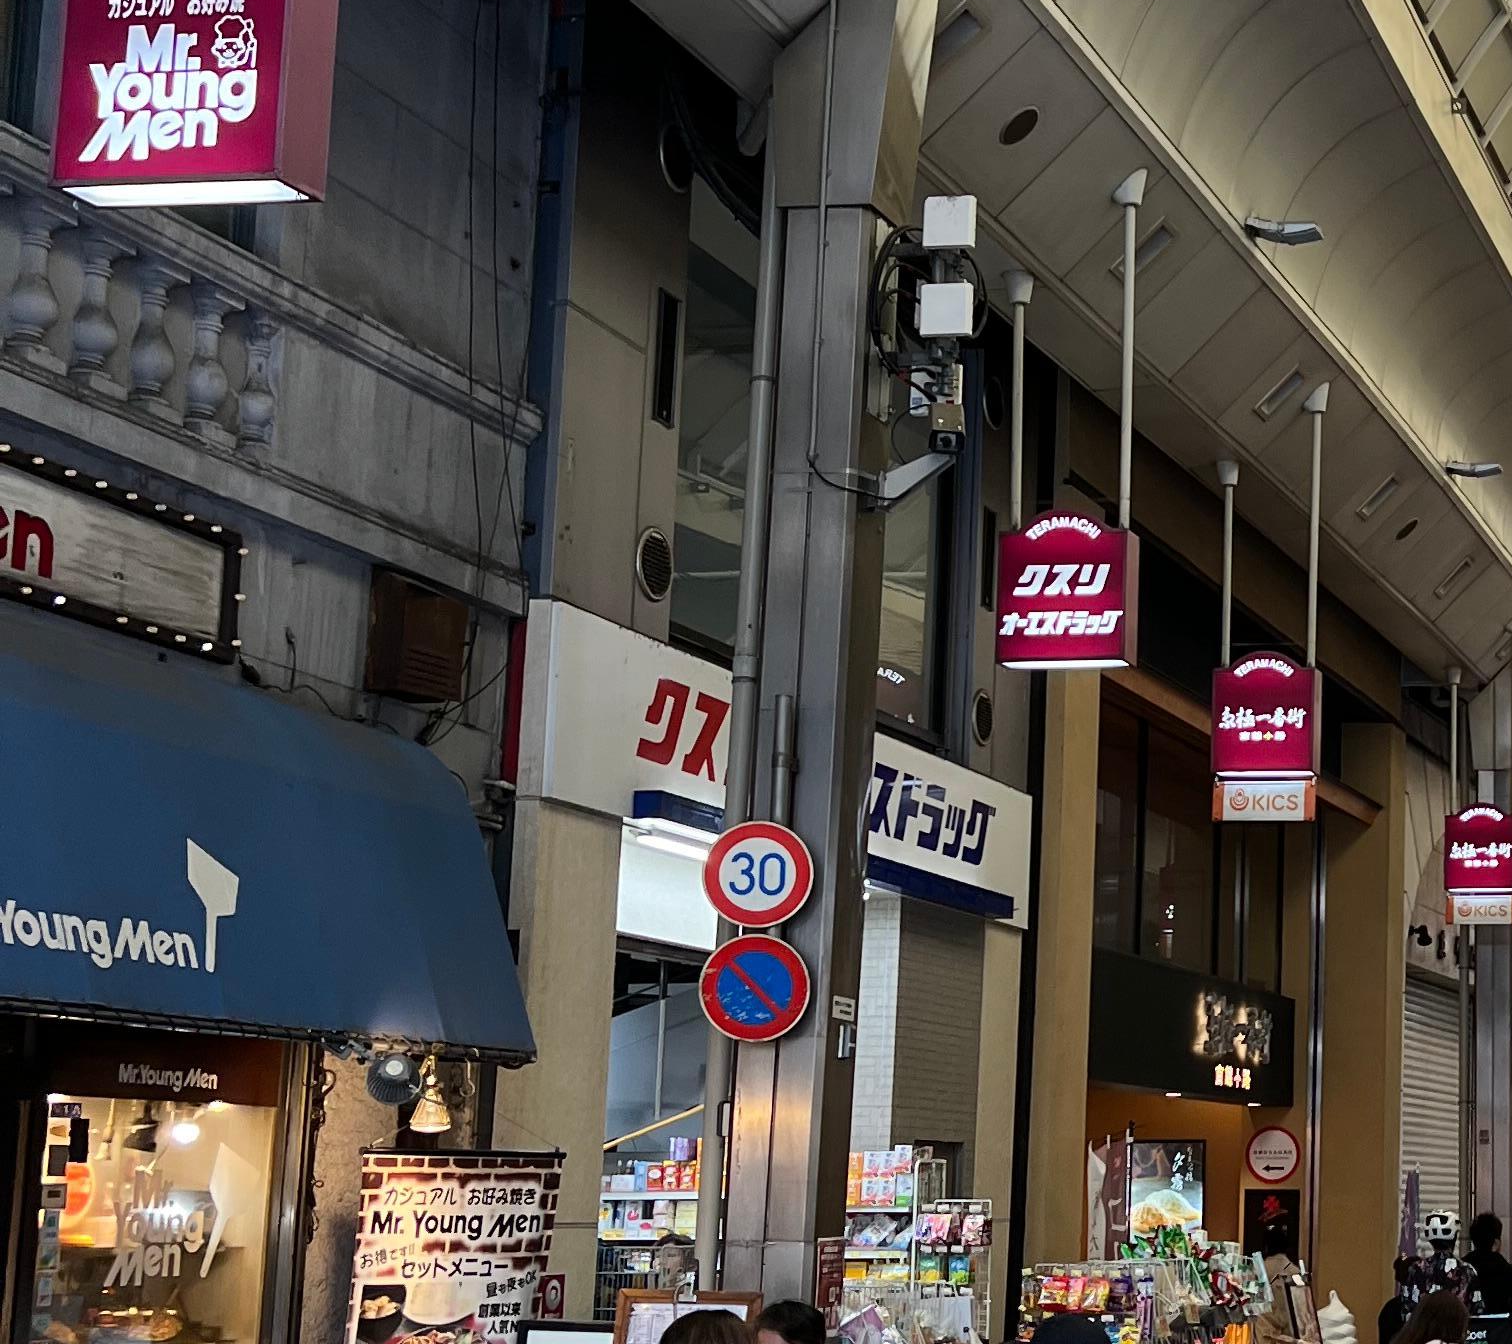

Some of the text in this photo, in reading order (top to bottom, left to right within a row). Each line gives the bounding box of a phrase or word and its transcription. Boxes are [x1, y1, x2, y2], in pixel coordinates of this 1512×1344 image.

[125, 23, 202, 74] Mr.
[89, 63, 257, 122] Young
[78, 110, 219, 162] Men
[1025, 516, 1101, 540] TERAMACHI
[1013, 563, 1111, 597] クスリ
[999, 610, 1124, 636] オーエスドラッグ
[1234, 658, 1294, 678] TERAMACHI
[1252, 788, 1299, 810] KICS
[728, 851, 787, 897] 30
[1474, 905, 1508, 917] KICS
[467, 1187, 538, 1206] お好み焼き
[113, 1201, 205, 1254] Young
[370, 1210, 542, 1241] Mr. Young Men
[103, 1242, 183, 1287] Men
[401, 1257, 509, 1279] セットメニュー
